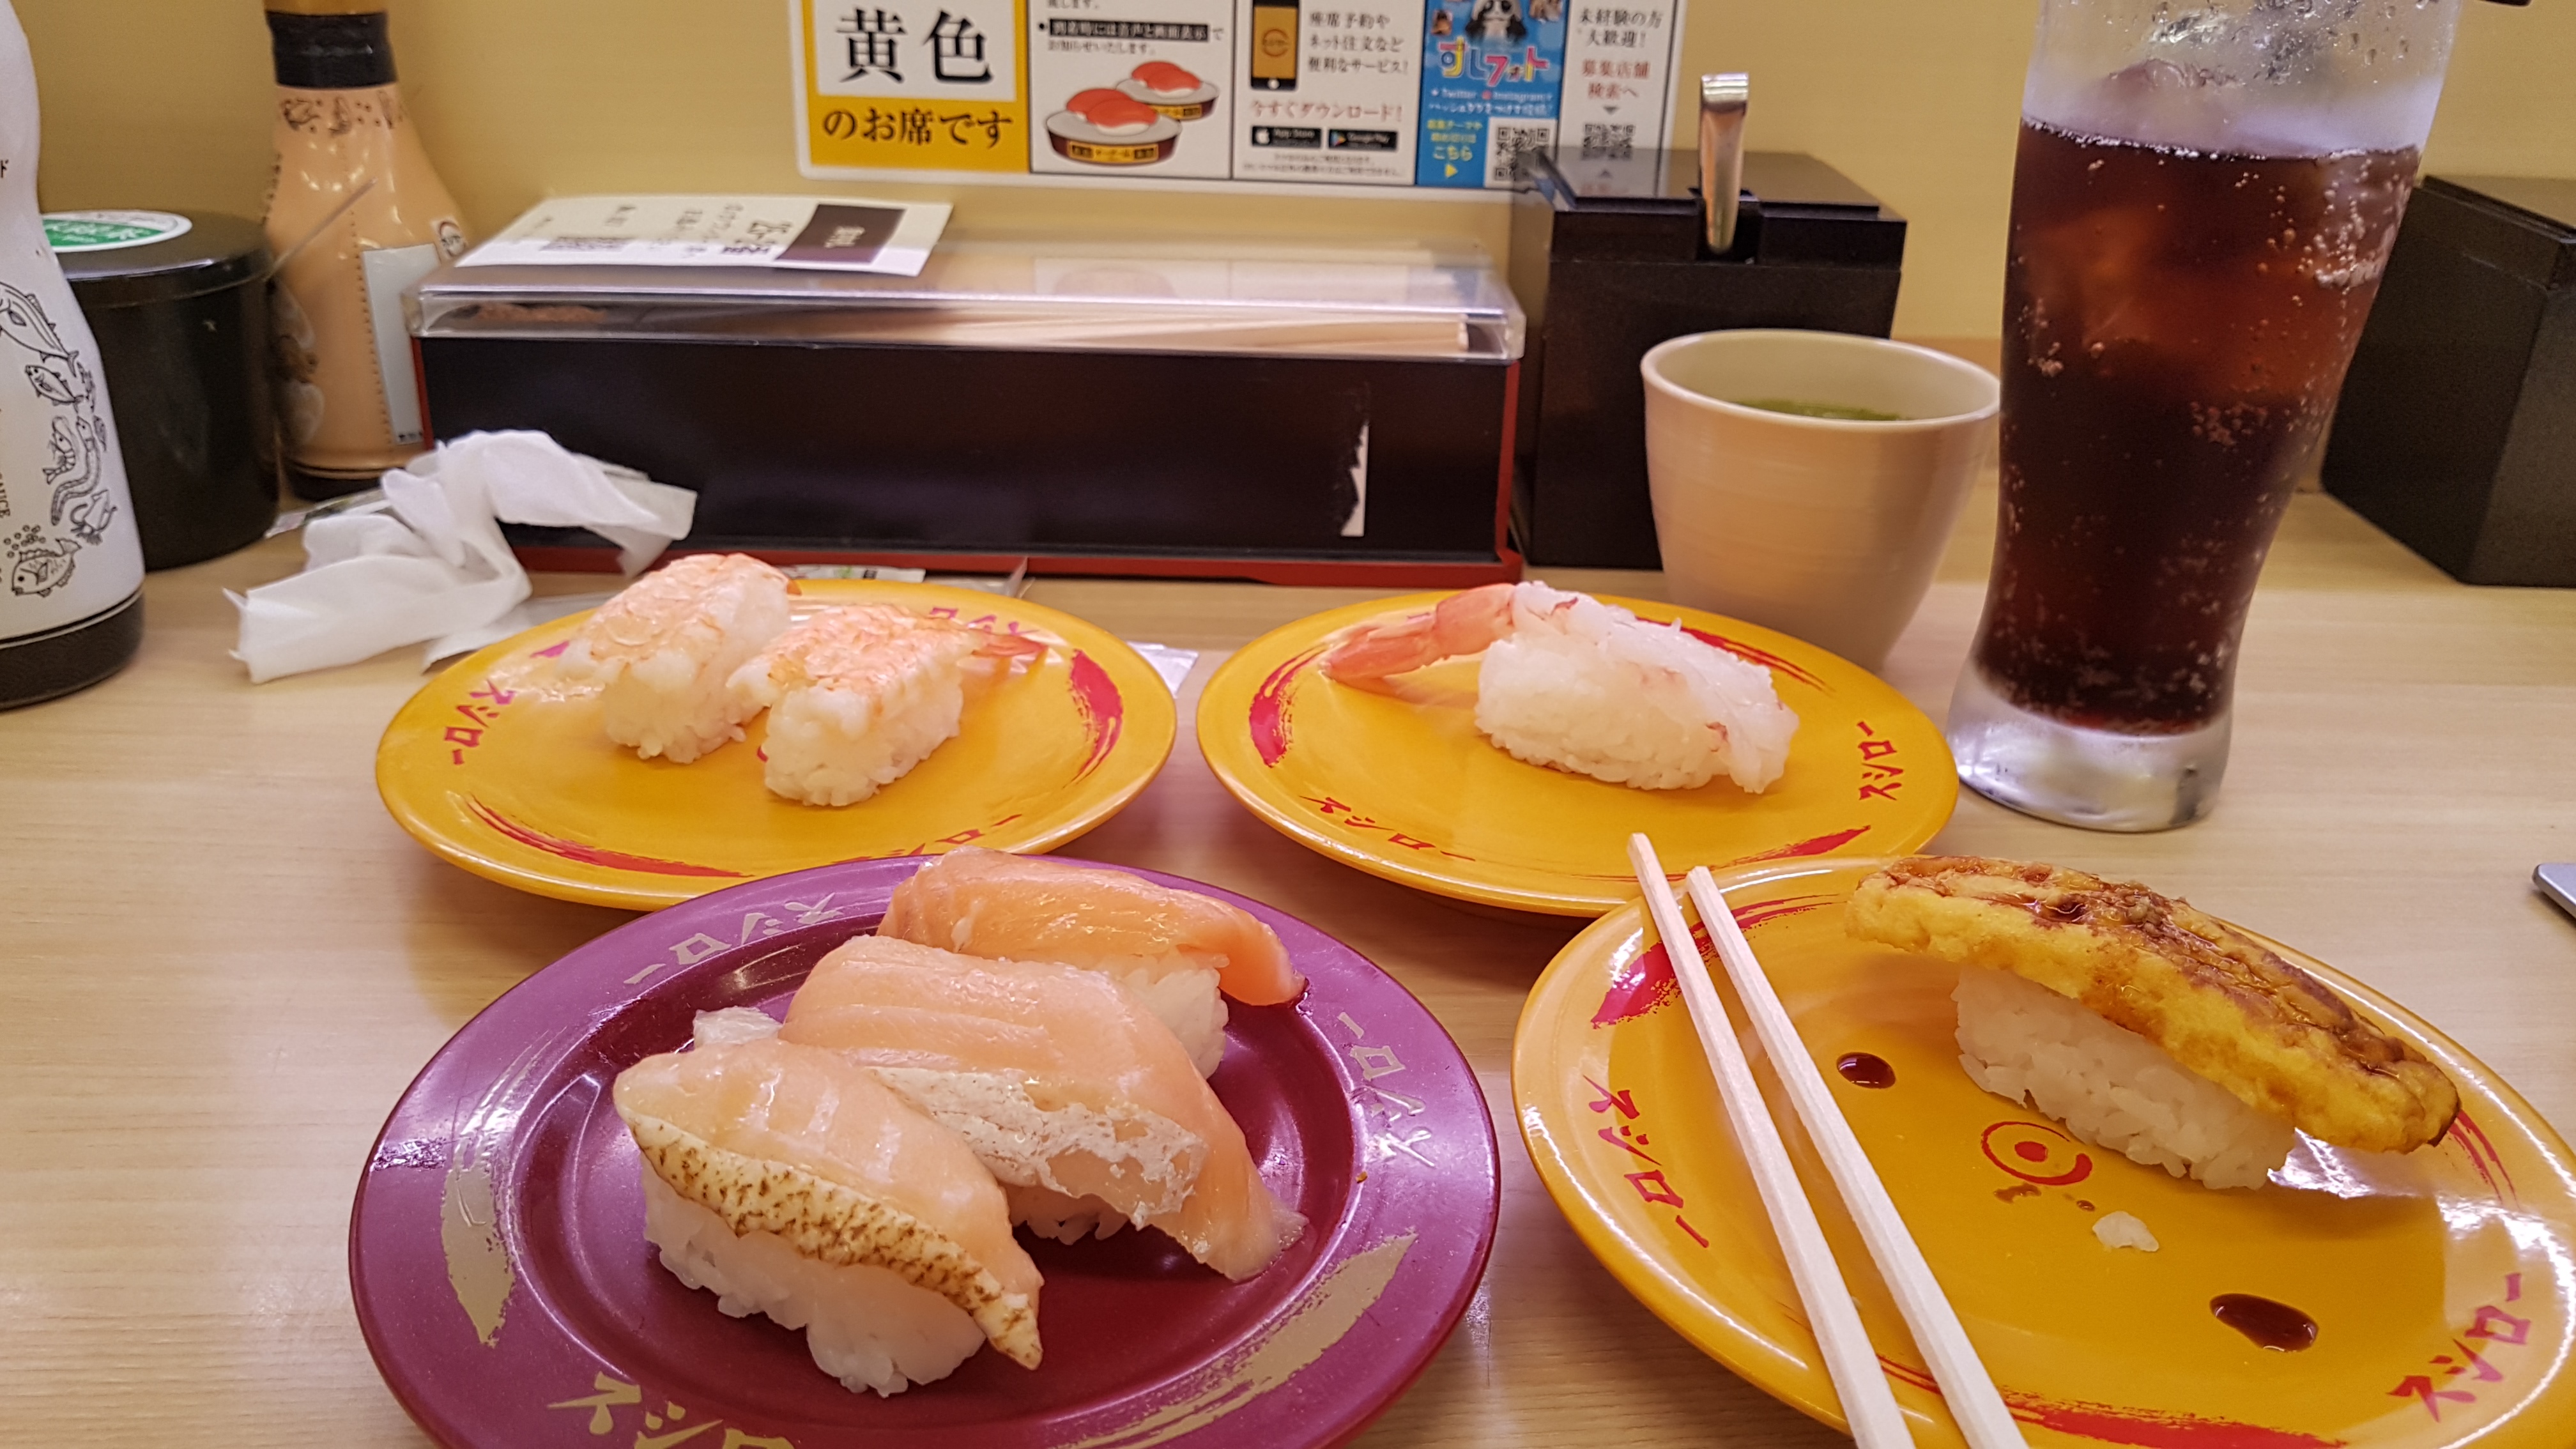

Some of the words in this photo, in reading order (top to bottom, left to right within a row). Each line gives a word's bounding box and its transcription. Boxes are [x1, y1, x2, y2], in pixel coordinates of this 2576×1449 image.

[836, 8, 995, 84] 黄色
[824, 107, 1013, 149] のお席です
[1433, 146, 1473, 161] こちら
[444, 679, 517, 765] スシロー
[1857, 720, 1903, 801] スシロー
[1298, 795, 1476, 862] スシロー
[624, 892, 843, 985] スシロー
[1337, 1011, 1436, 1167] スシロー
[1583, 1075, 1710, 1248] スシロー
[2386, 1272, 2531, 1423] スシロー
